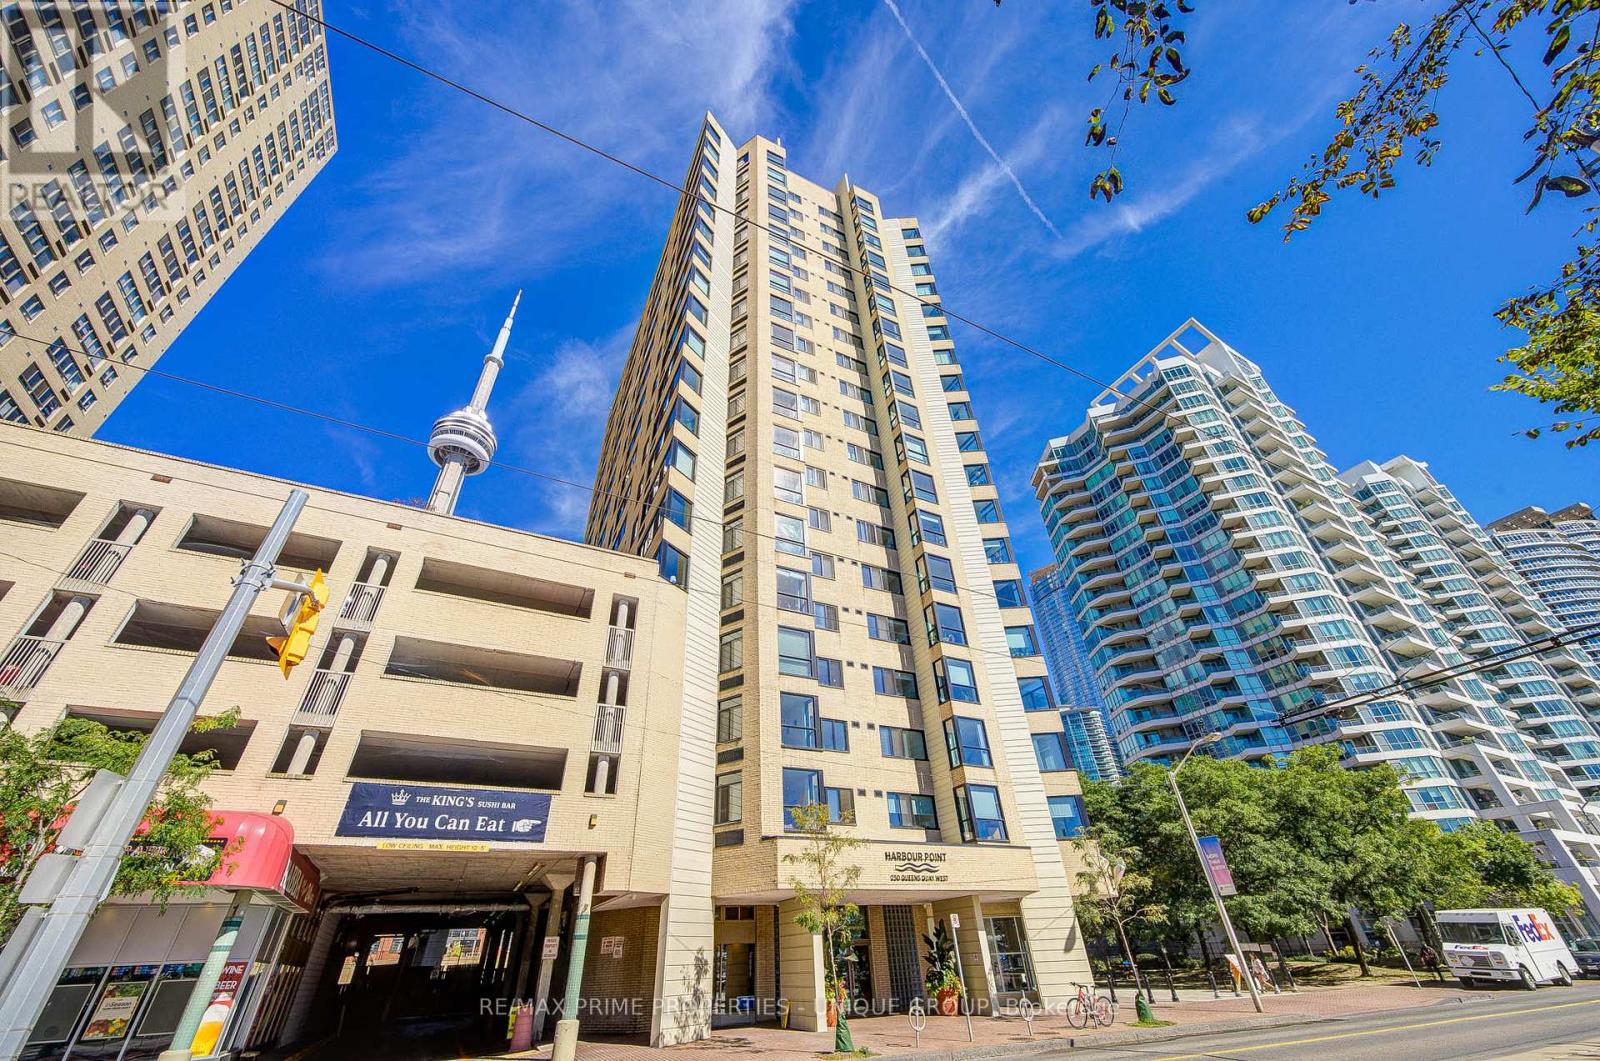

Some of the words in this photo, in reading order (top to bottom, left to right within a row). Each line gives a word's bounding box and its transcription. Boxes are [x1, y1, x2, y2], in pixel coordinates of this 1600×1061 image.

[432, 795, 474, 807] KING'S
[477, 801, 500, 809] SUSHI
[501, 802, 516, 810] BAR
[357, 811, 389, 828] All
[395, 812, 429, 829] You
[434, 814, 469, 830] Can
[475, 816, 505, 832] Eat
[885, 851, 923, 862] HARBOUR
[924, 852, 946, 862] POINT
[1512, 912, 1555, 942] FedEx
